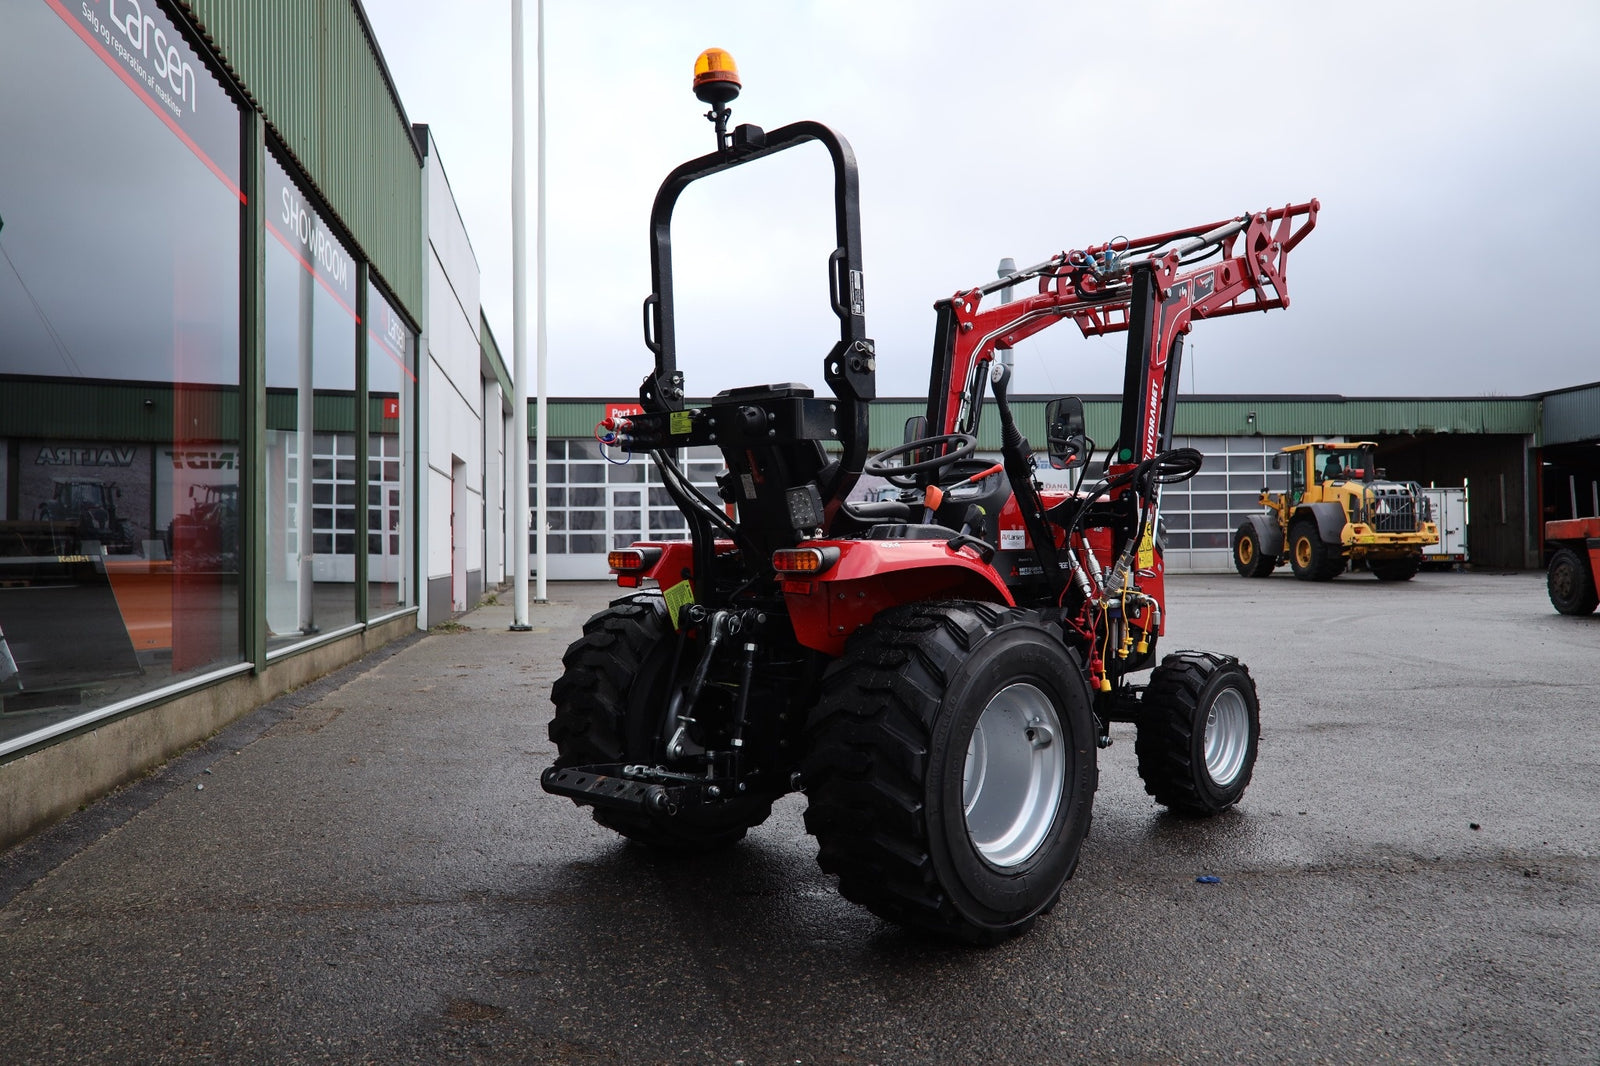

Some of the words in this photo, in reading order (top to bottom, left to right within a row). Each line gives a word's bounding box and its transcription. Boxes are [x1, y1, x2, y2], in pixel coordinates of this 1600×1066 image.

[82, 1, 99, 33] Salg
[100, 22, 110, 45] og
[111, 38, 148, 81] reparation
[147, 75, 155, 89] af
[155, 84, 182, 118] maskiner
[282, 186, 348, 291] SHOWROOM
[611, 408, 630, 418] Port
[1146, 379, 1159, 455] HYDRAMET
